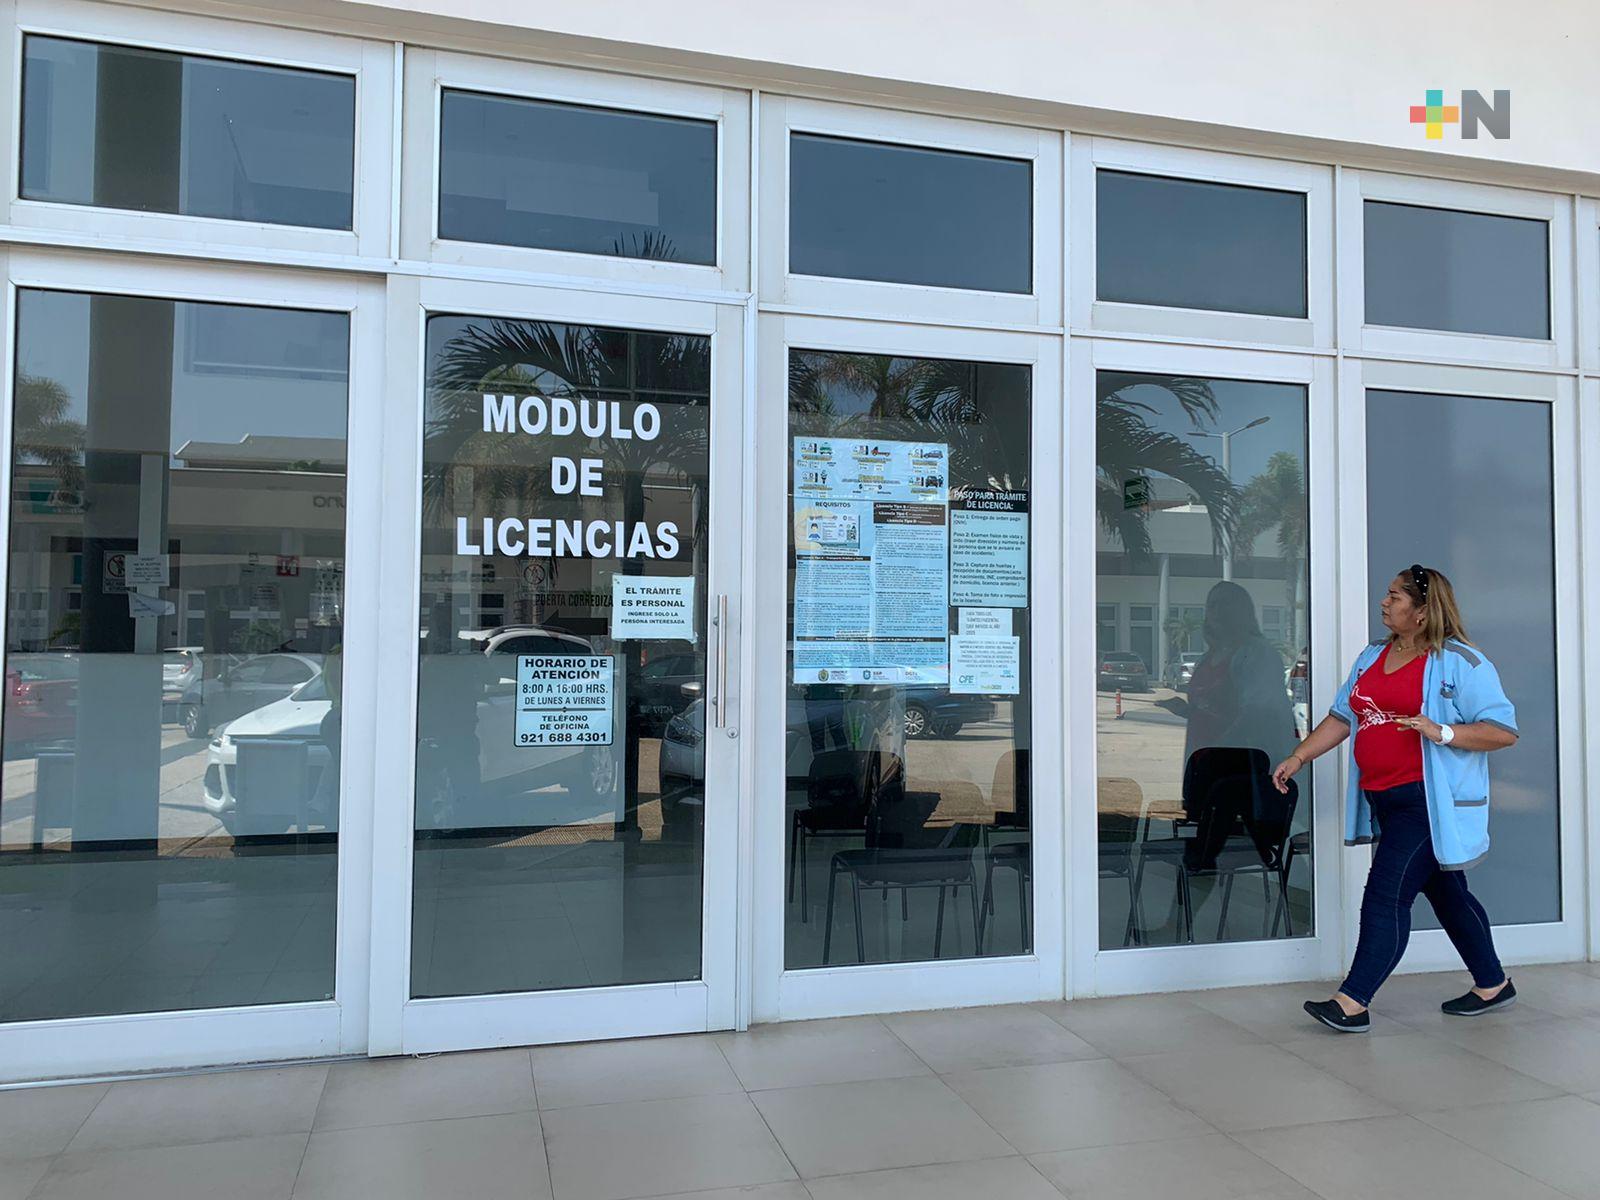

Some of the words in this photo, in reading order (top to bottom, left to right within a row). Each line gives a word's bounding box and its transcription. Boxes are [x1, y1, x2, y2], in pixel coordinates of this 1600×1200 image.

[483, 394, 661, 441] MODULO
[551, 457, 604, 496] DE
[975, 491, 994, 500] PARA
[996, 490, 1027, 502] TRÁMITE
[966, 501, 977, 509] DE
[978, 502, 1014, 510] LICENCIA:
[456, 517, 679, 559] LICENCIAS
[535, 594, 566, 607] PUERTA
[568, 594, 614, 607] CORREDIZA
[525, 659, 586, 668] HORARIO
[590, 659, 608, 668] DE
[531, 668, 600, 680] ATENCIÓN
[522, 684, 544, 694] 8:00
[546, 684, 553, 693] A
[557, 684, 583, 694] 16:00
[586, 684, 608, 694] HRS.
[524, 697, 536, 705] DE
[538, 697, 563, 705] LUNES
[573, 697, 606, 705] VIERNES
[542, 713, 588, 722] TELÉFONO
[521, 734, 543, 743] 921
[549, 733, 572, 742] 688
[576, 732, 606, 742] 4301
